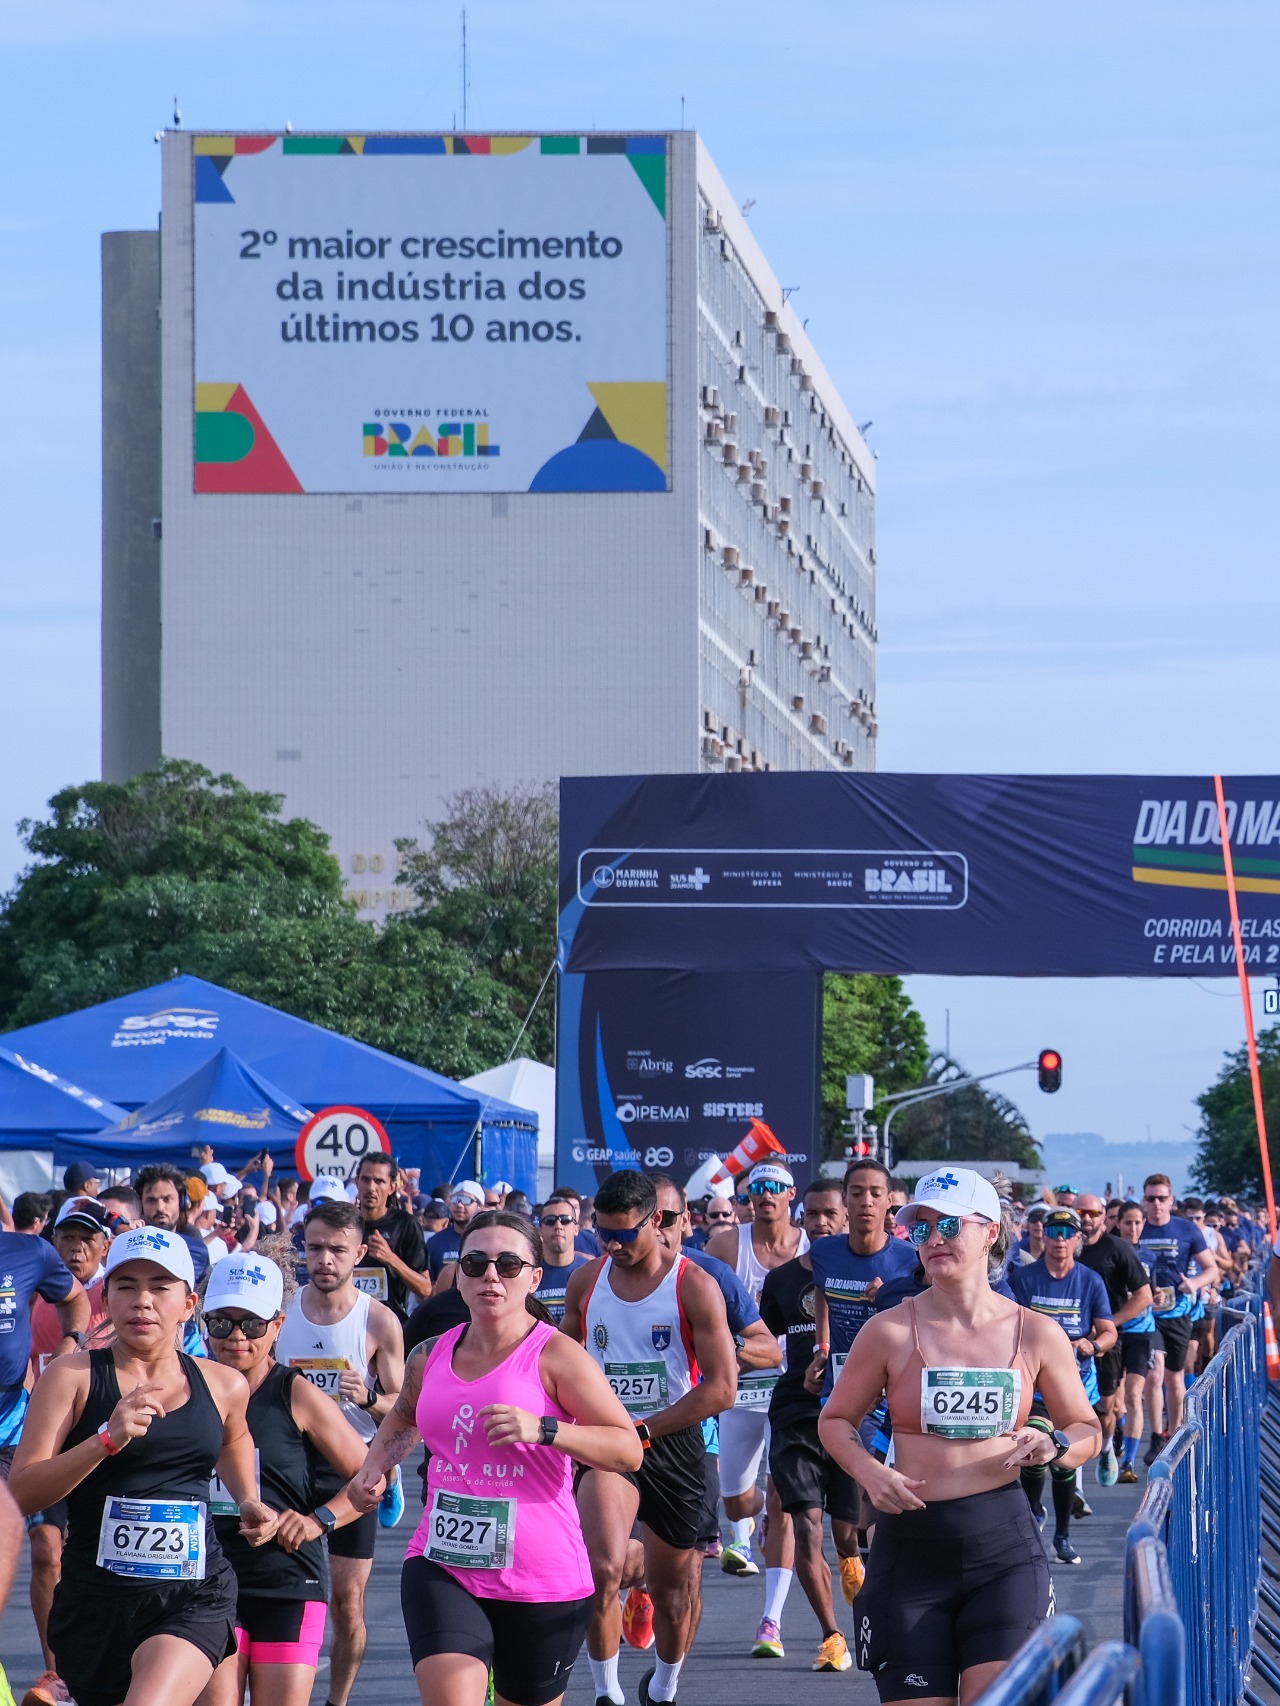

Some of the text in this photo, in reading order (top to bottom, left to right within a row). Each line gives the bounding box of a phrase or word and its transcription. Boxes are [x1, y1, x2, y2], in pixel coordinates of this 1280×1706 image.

[239, 230, 623, 259] 2º maior crescimento
[276, 271, 586, 301] da indústria dos
[281, 312, 582, 343] últimos 10 anos.
[374, 408, 489, 417] GOVERNO FEDERAL
[363, 423, 500, 457] BRASIL
[1133, 800, 1187, 845] DIA
[1189, 800, 1237, 845] DO
[616, 869, 659, 878] MARINHA
[670, 874, 687, 882] SUS
[723, 870, 768, 878] MINISTÉRIO
[794, 870, 840, 878] MINISTÉRIO
[865, 868, 952, 893] BRASIL
[827, 879, 852, 887] SAÚDE
[1143, 918, 1222, 938] CORRIDA
[1153, 945, 1166, 963] E
[1170, 945, 1214, 963] PELA
[639, 1058, 673, 1073] Abrig
[636, 1105, 689, 1118] IPEMAI
[315, 1123, 369, 1157] 40
[586, 1147, 641, 1160] GEAP saúde
[315, 1162, 359, 1178] km/
[127, 1234, 145, 1244] SUS
[229, 1268, 245, 1276] SUS
[842, 1280, 869, 1291] MARINH
[788, 1323, 816, 1334] LEONAR
[609, 1378, 655, 1396] 6257
[933, 1391, 999, 1414] 6245
[1004, 1392, 1013, 1413] 5KM
[483, 1464, 524, 1478] RUN
[435, 1514, 492, 1545] 6227
[498, 1523, 506, 1545] 5KM
[113, 1524, 184, 1553] 6723
[190, 1529, 199, 1552] 5KM
[116, 1550, 146, 1559] FLAVIANA
[459, 1543, 478, 1551] GOMES
